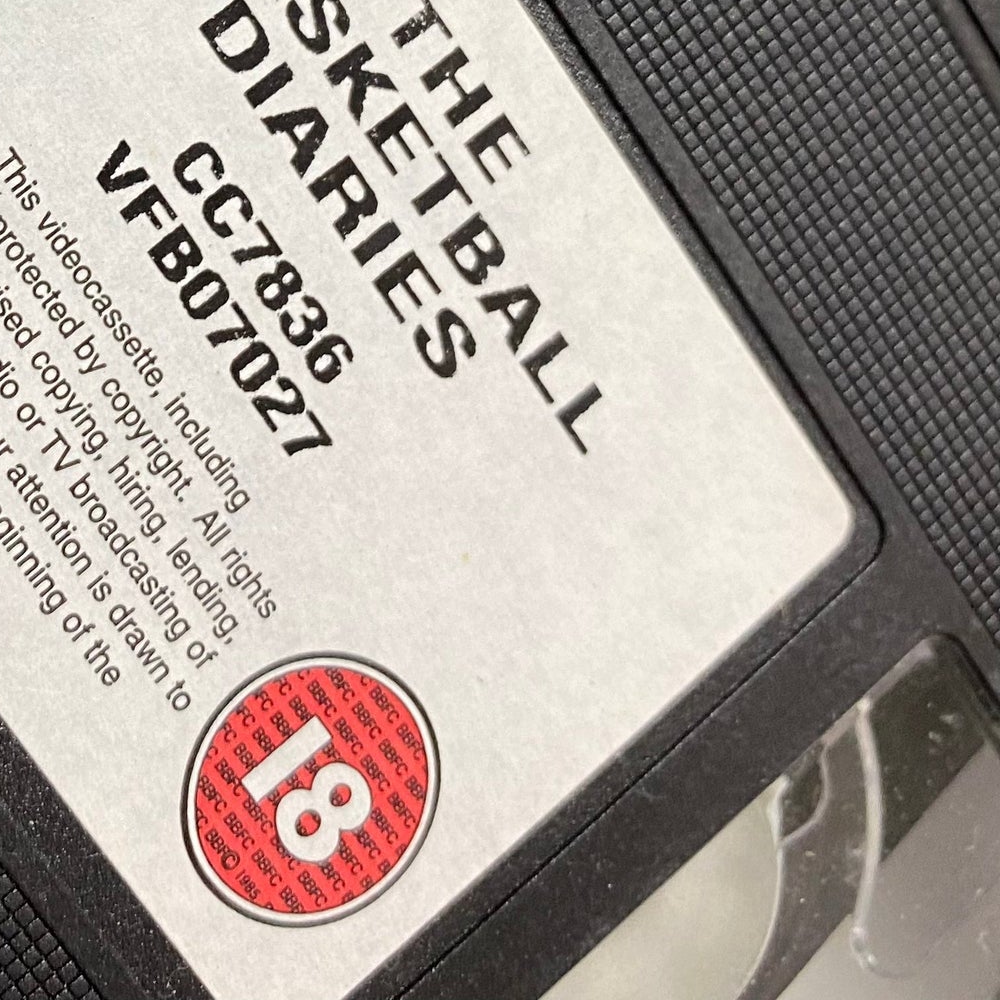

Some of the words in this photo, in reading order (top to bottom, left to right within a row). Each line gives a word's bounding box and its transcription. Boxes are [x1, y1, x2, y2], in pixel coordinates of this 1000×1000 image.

[38, 210, 163, 398] videocassette,
[164, 391, 250, 513] including
[96, 140, 333, 456] VFB07027
[173, 141, 354, 384] CC7836
[6, 463, 91, 576] attention
[87, 570, 111, 601] is
[108, 604, 169, 683] drawn
[165, 679, 191, 711] to
[16, 403, 46, 431] or
[41, 427, 81, 471] TV
[68, 472, 191, 642] broadcasting
[186, 641, 218, 668] of
[31, 351, 109, 461] copying,
[108, 455, 167, 544] hiring,
[166, 537, 239, 644] lending,
[73, 334, 107, 375] by
[101, 378, 193, 502] copyright.
[192, 510, 231, 547] All
[221, 547, 276, 618] rights
[62, 613, 95, 641] of
[84, 639, 120, 686] the
[307, 679, 337, 717] BBFC
[333, 716, 364, 755] BBFC
[360, 754, 390, 792] BBFC
[351, 700, 382, 740] BBFC
[379, 738, 408, 776] BBFC
[223, 811, 255, 850] BBFC
[252, 848, 282, 887] BBFC
[241, 714, 372, 863] 18
